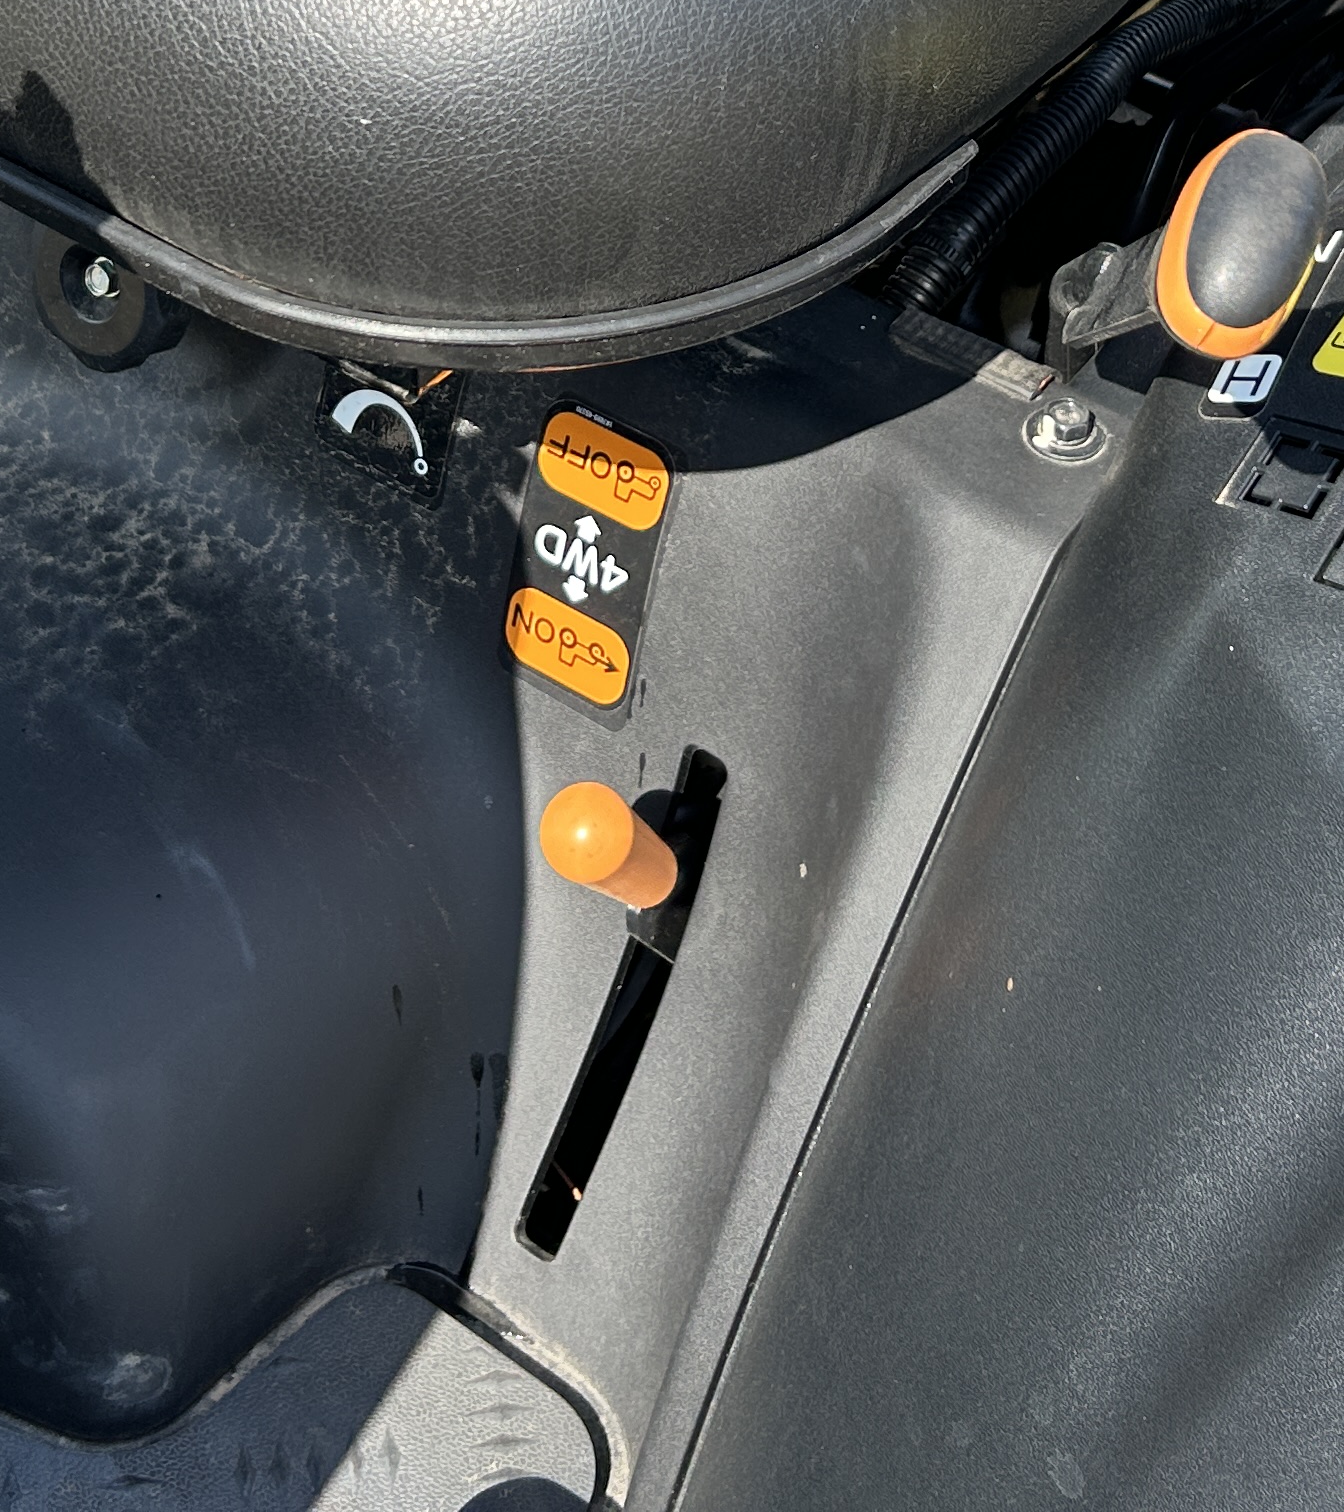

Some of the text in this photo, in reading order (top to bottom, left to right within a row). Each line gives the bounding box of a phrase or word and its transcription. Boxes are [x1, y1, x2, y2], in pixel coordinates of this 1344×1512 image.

[1220, 360, 1272, 396] H
[547, 435, 611, 479] OFF
[534, 524, 629, 593] 4WD
[511, 603, 555, 643] ON
